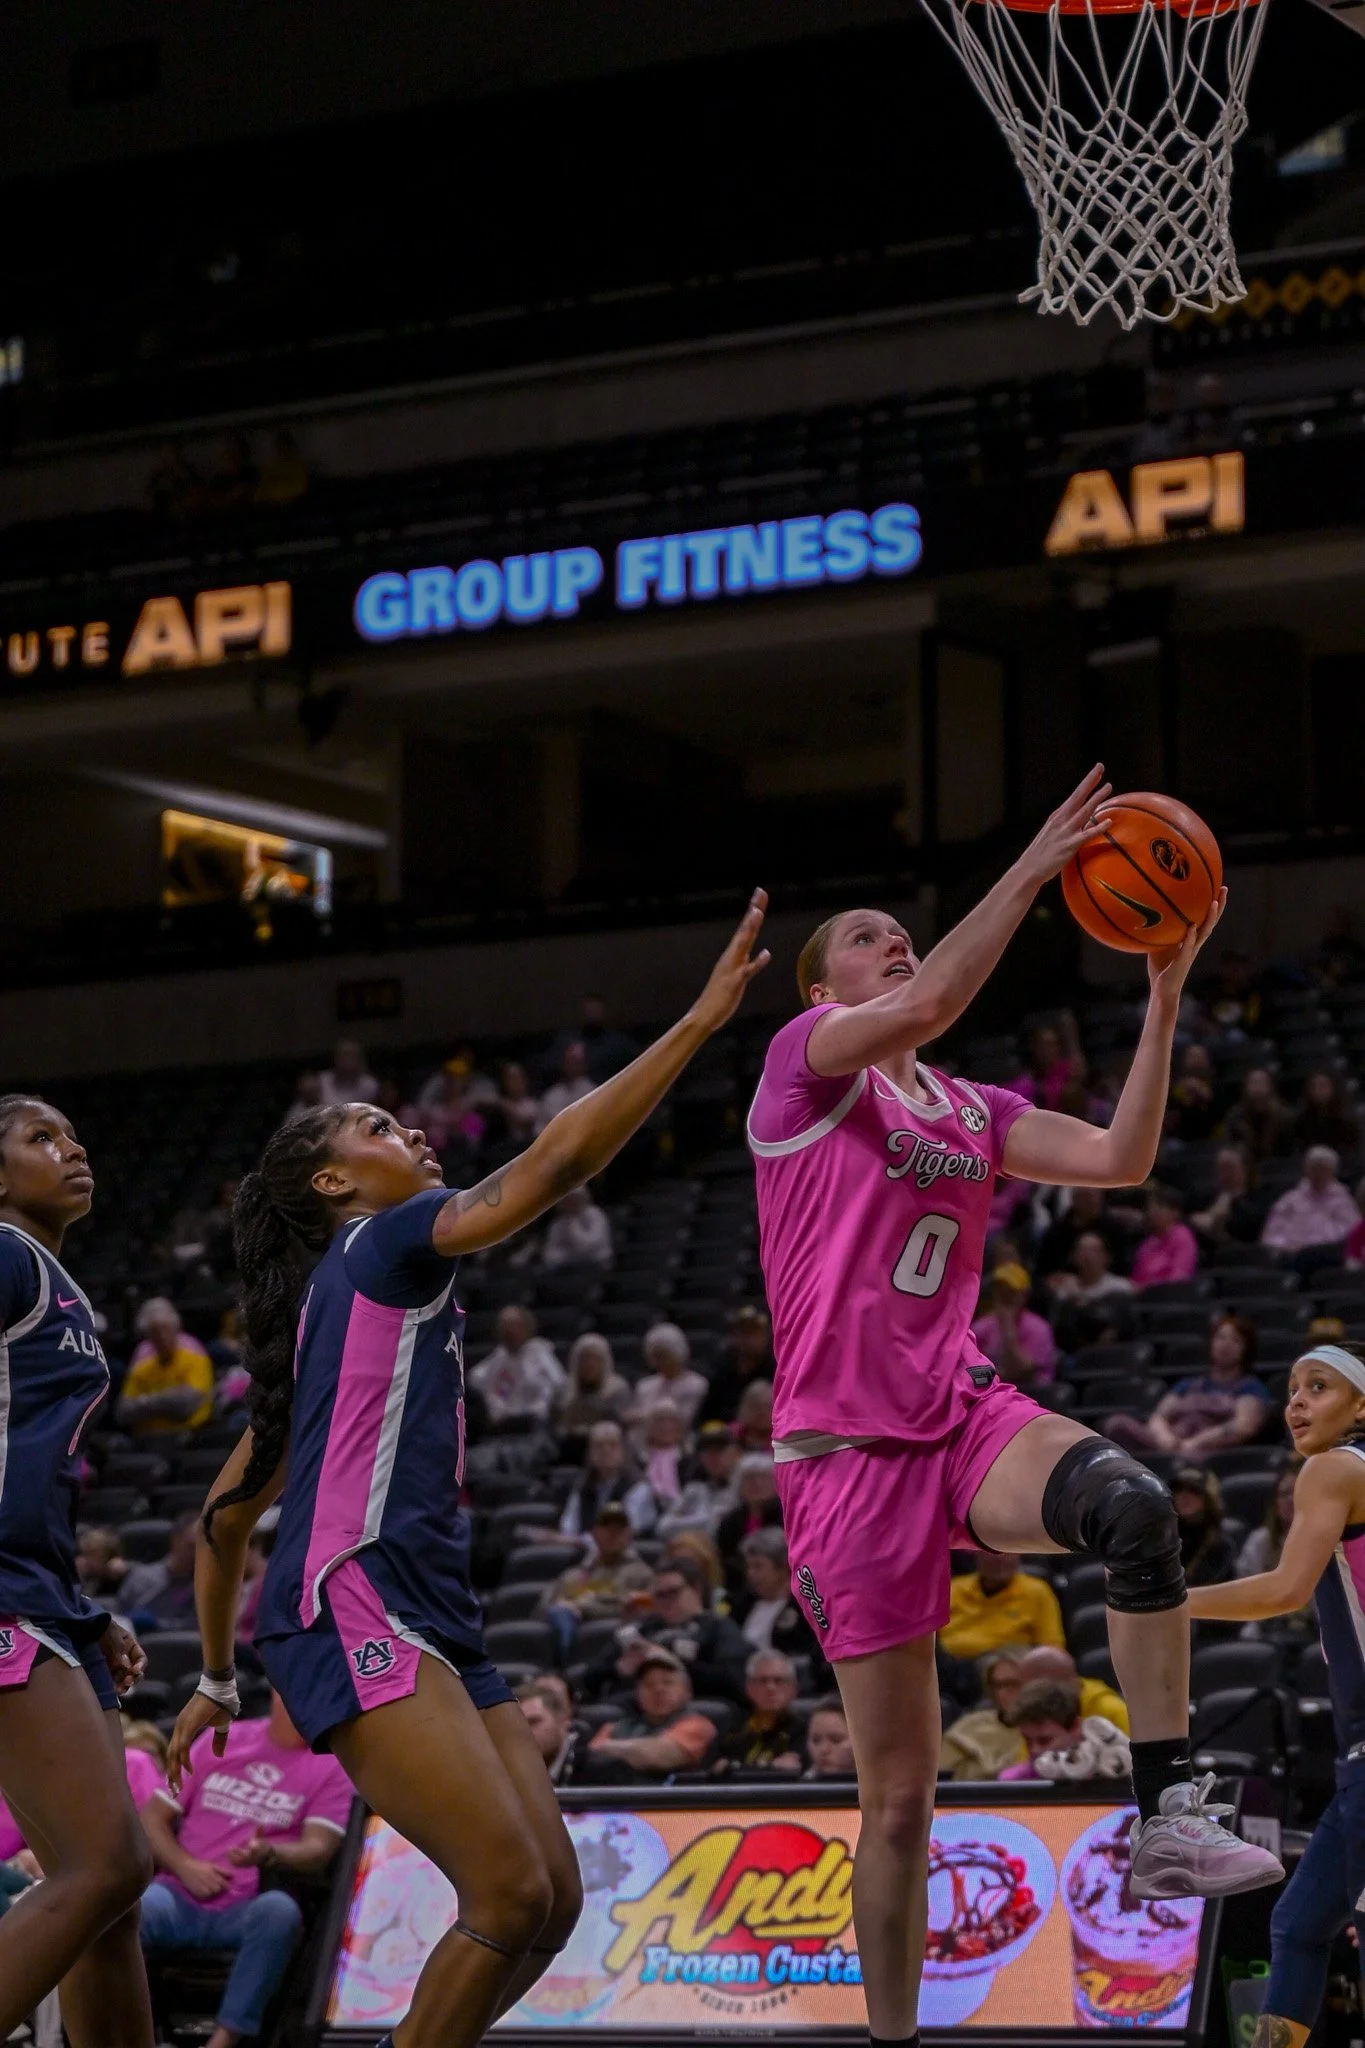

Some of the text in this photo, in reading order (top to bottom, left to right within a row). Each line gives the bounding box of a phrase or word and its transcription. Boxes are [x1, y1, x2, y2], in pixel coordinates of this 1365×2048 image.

[1046, 451, 1246, 556] API
[354, 502, 923, 643] GROUP FITNESS
[0, 620, 111, 679] UTE
[122, 580, 292, 677] API
[886, 1129, 990, 1189] Tigers
[891, 1212, 961, 1299] 0
[796, 1565, 829, 1630] Tigers
[639, 1943, 864, 1986] Frozen Custa
